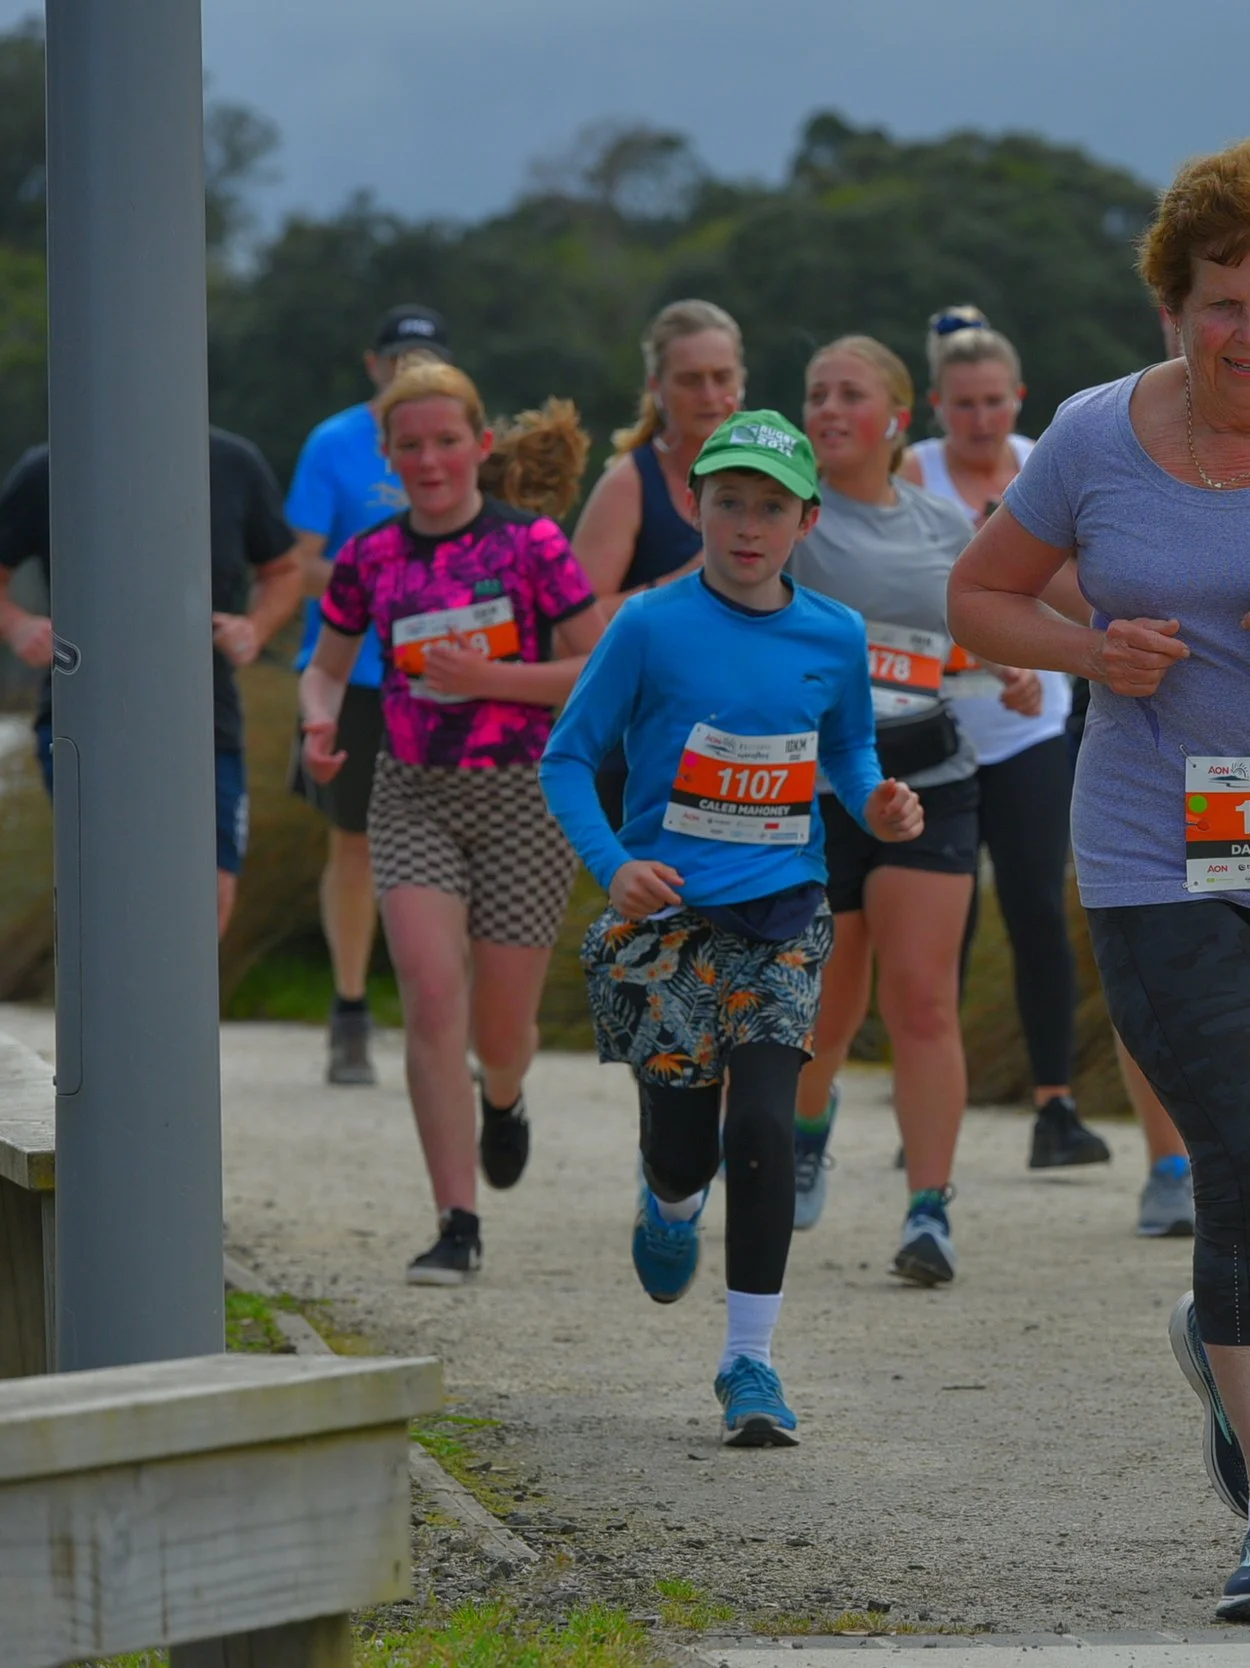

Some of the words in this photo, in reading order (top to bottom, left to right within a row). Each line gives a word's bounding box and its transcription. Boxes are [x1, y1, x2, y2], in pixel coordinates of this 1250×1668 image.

[1208, 766, 1229, 775] AON
[718, 768, 789, 800] 1107
[699, 799, 737, 814] CALEB
[738, 805, 791, 816] MAHONEY
[1207, 865, 1229, 873] AON
